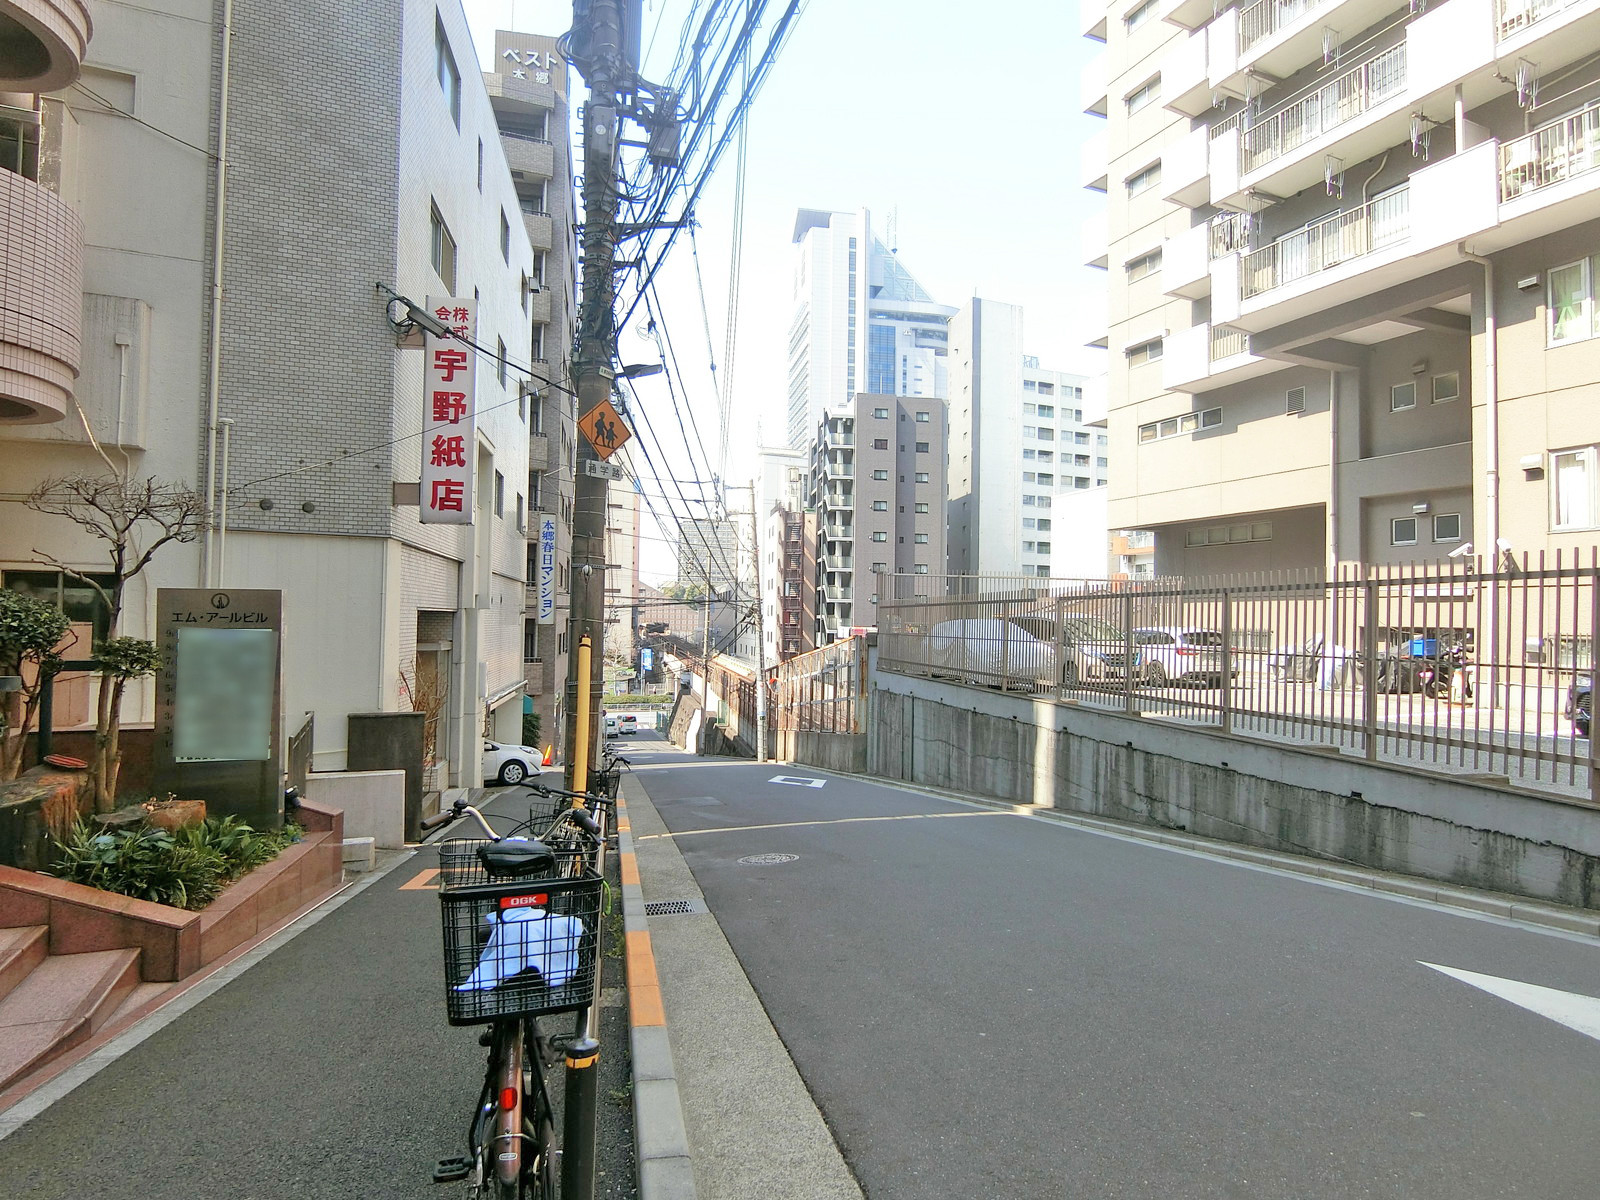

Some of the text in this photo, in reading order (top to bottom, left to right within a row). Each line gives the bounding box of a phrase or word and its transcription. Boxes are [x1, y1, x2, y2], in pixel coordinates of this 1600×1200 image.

[502, 48, 558, 70] ベスト
[430, 349, 468, 512] 宇野紙店
[540, 520, 555, 619] 本郷春日マンション
[172, 612, 268, 624] エム・アールビル
[511, 896, 537, 905] OGK
